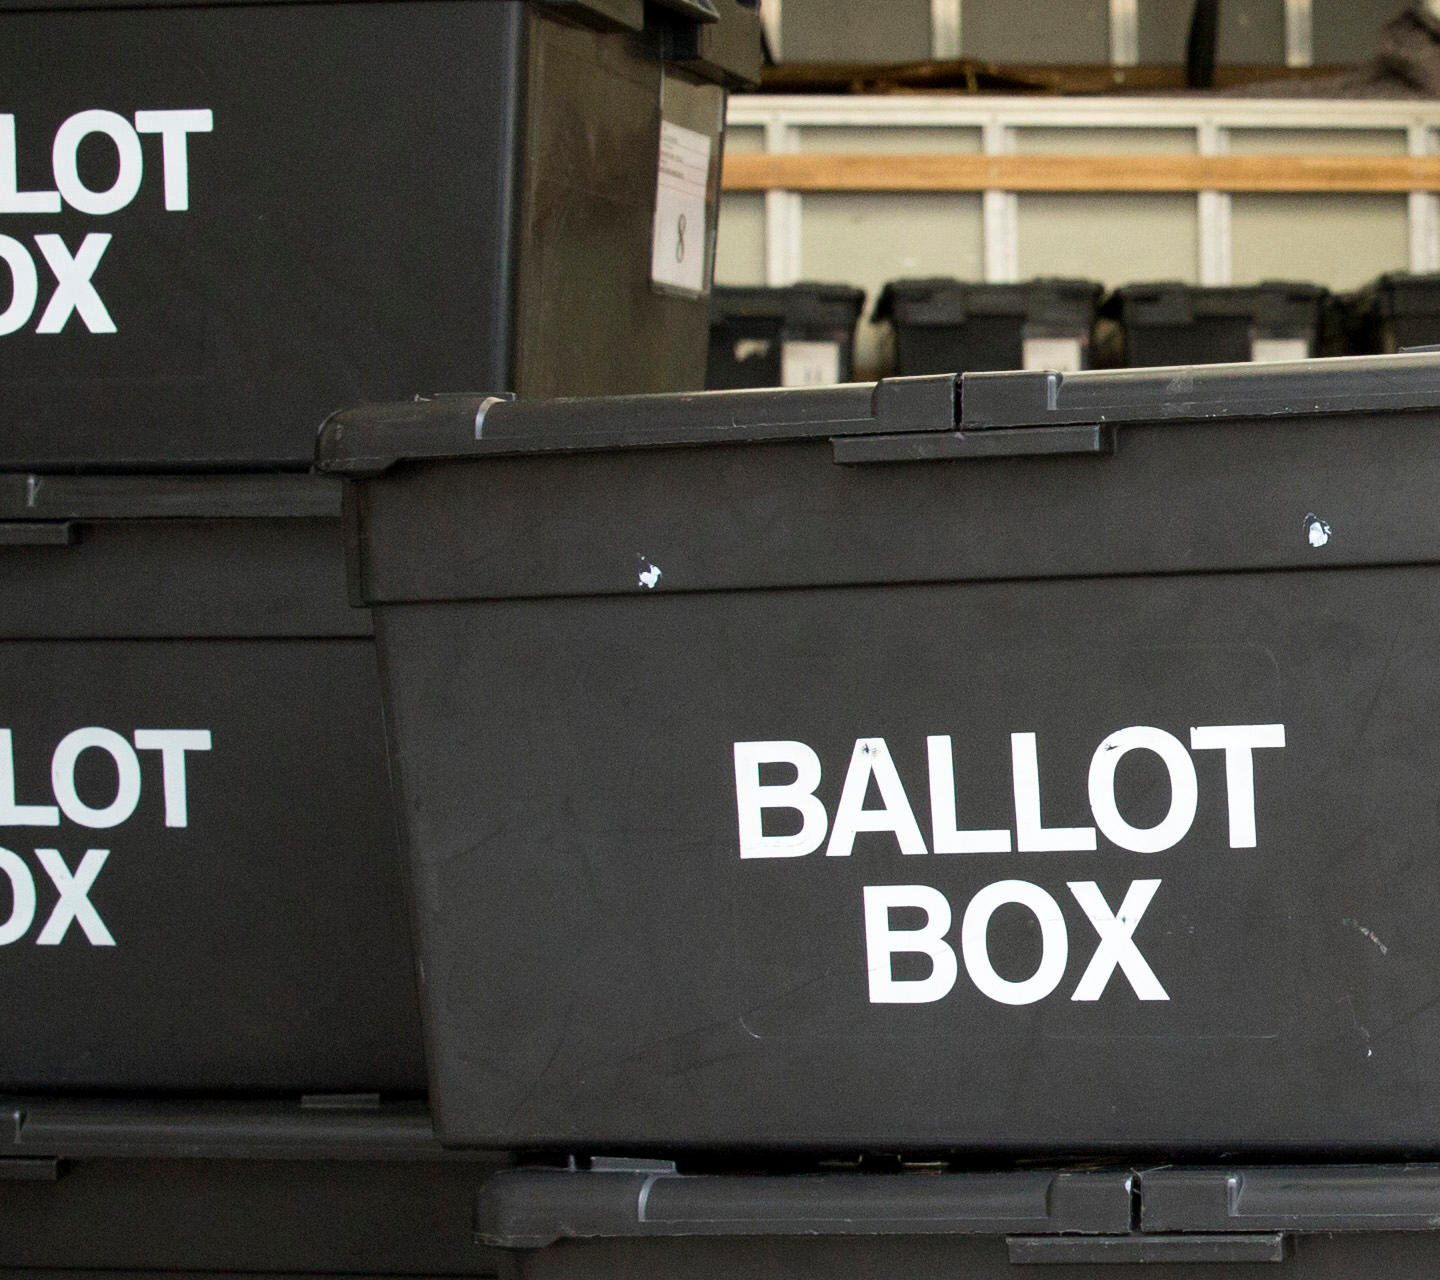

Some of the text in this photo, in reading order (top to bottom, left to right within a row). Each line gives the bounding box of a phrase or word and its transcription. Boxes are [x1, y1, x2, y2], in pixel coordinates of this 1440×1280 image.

[675, 211, 688, 265] 8
[734, 724, 1286, 859] BALLOT
[863, 879, 1170, 1005] BOX
